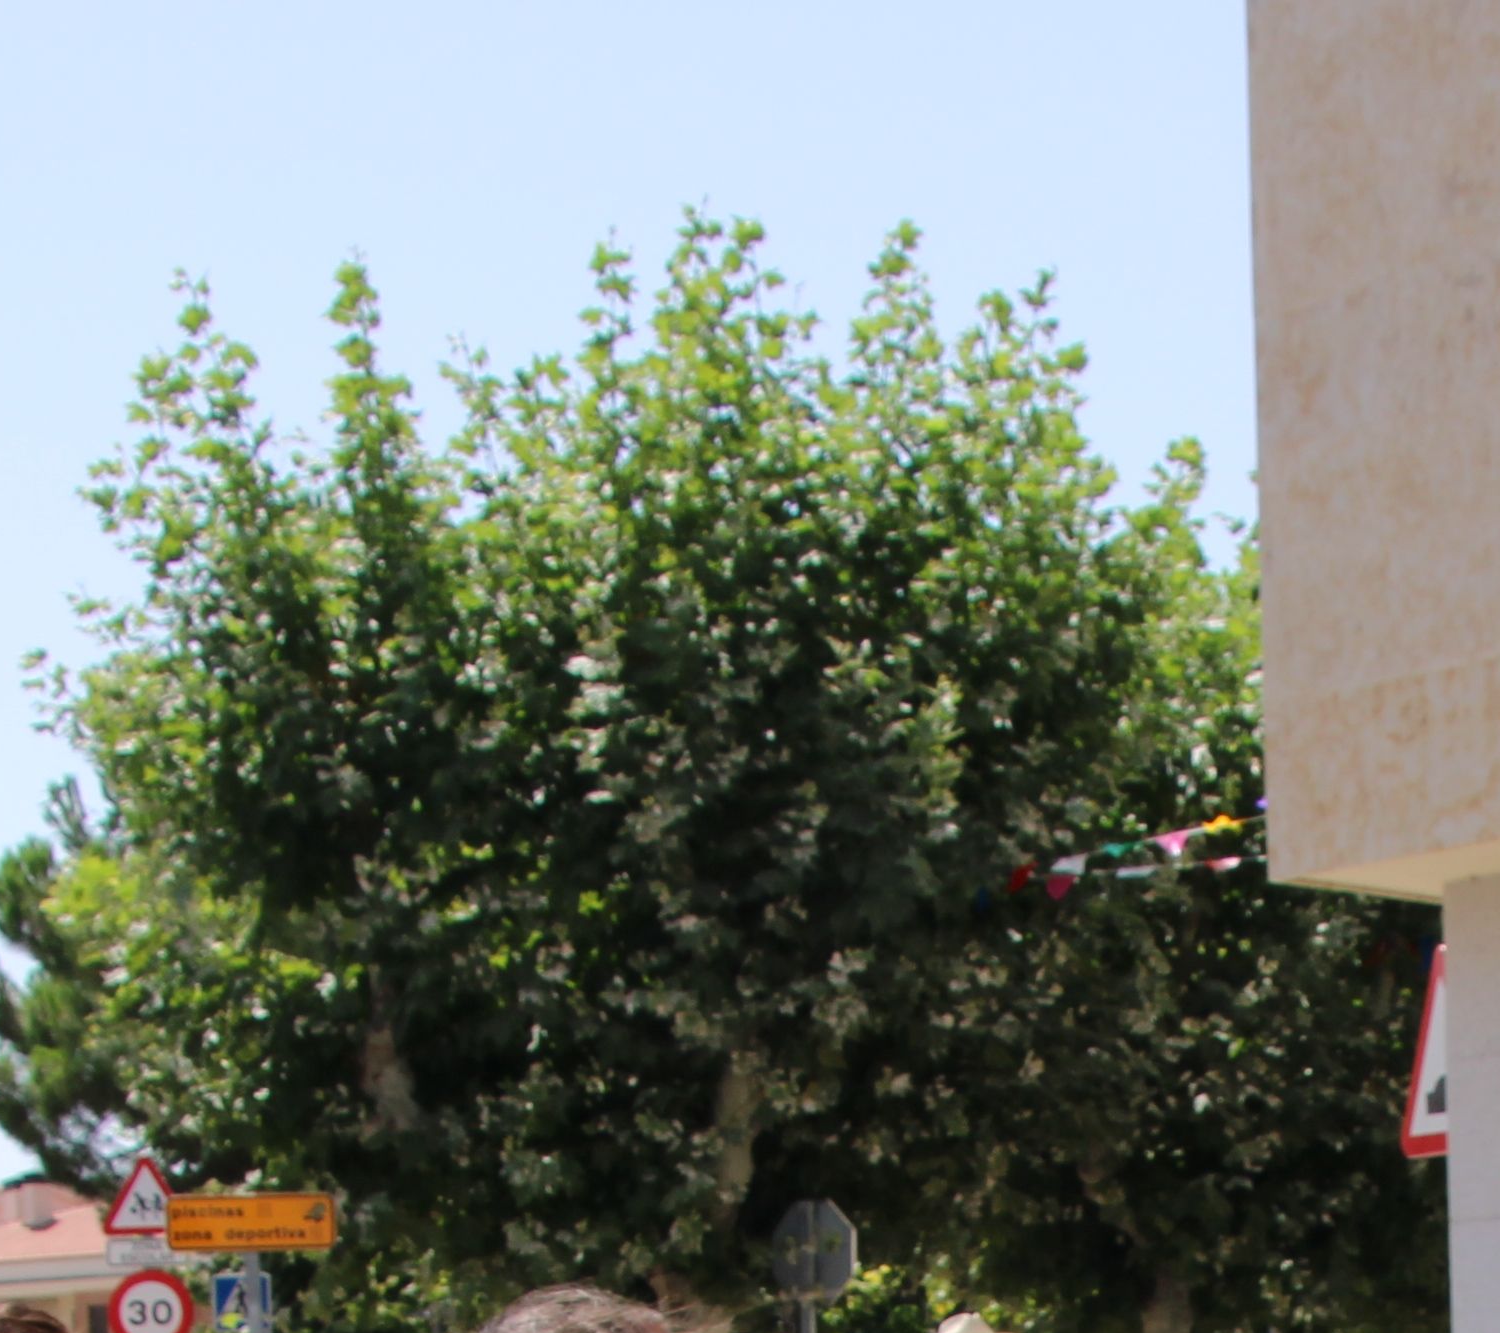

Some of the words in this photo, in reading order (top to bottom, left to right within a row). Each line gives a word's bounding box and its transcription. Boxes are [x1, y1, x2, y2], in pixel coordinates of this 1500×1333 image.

[172, 1205, 244, 1218] piscinas
[174, 1229, 212, 1241] zona
[226, 1226, 305, 1241] deportiva
[129, 1299, 173, 1325] 30
